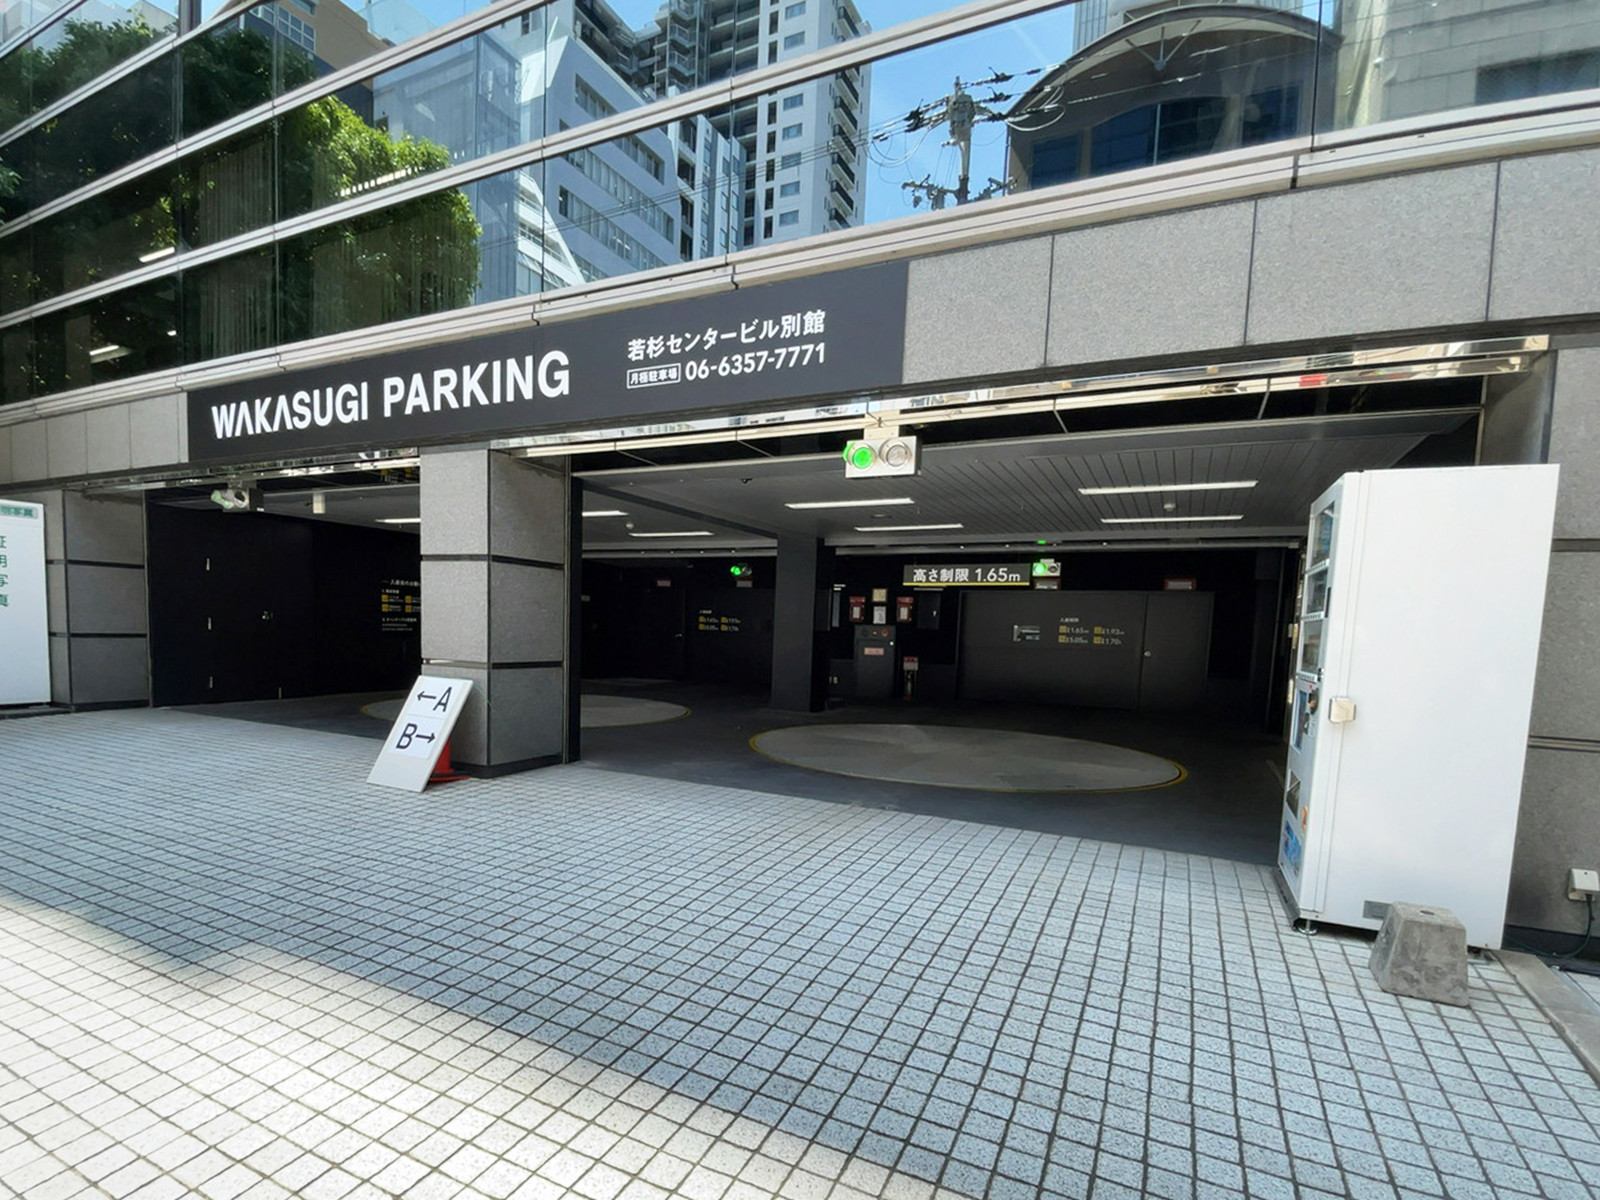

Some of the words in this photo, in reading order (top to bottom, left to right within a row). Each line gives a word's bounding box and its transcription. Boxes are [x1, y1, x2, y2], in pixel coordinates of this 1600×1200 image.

[627, 309, 826, 362] 若杉センタービル別館
[630, 368, 678, 385] 月極駐車場
[685, 342, 826, 381] 06-6357-7771
[211, 381, 369, 440] WAKASUGI
[383, 350, 571, 418] PARKING
[913, 568, 970, 583] 高さ制限
[974, 567, 1021, 583] 1.65m
[432, 686, 452, 712] A
[396, 722, 418, 750] B
